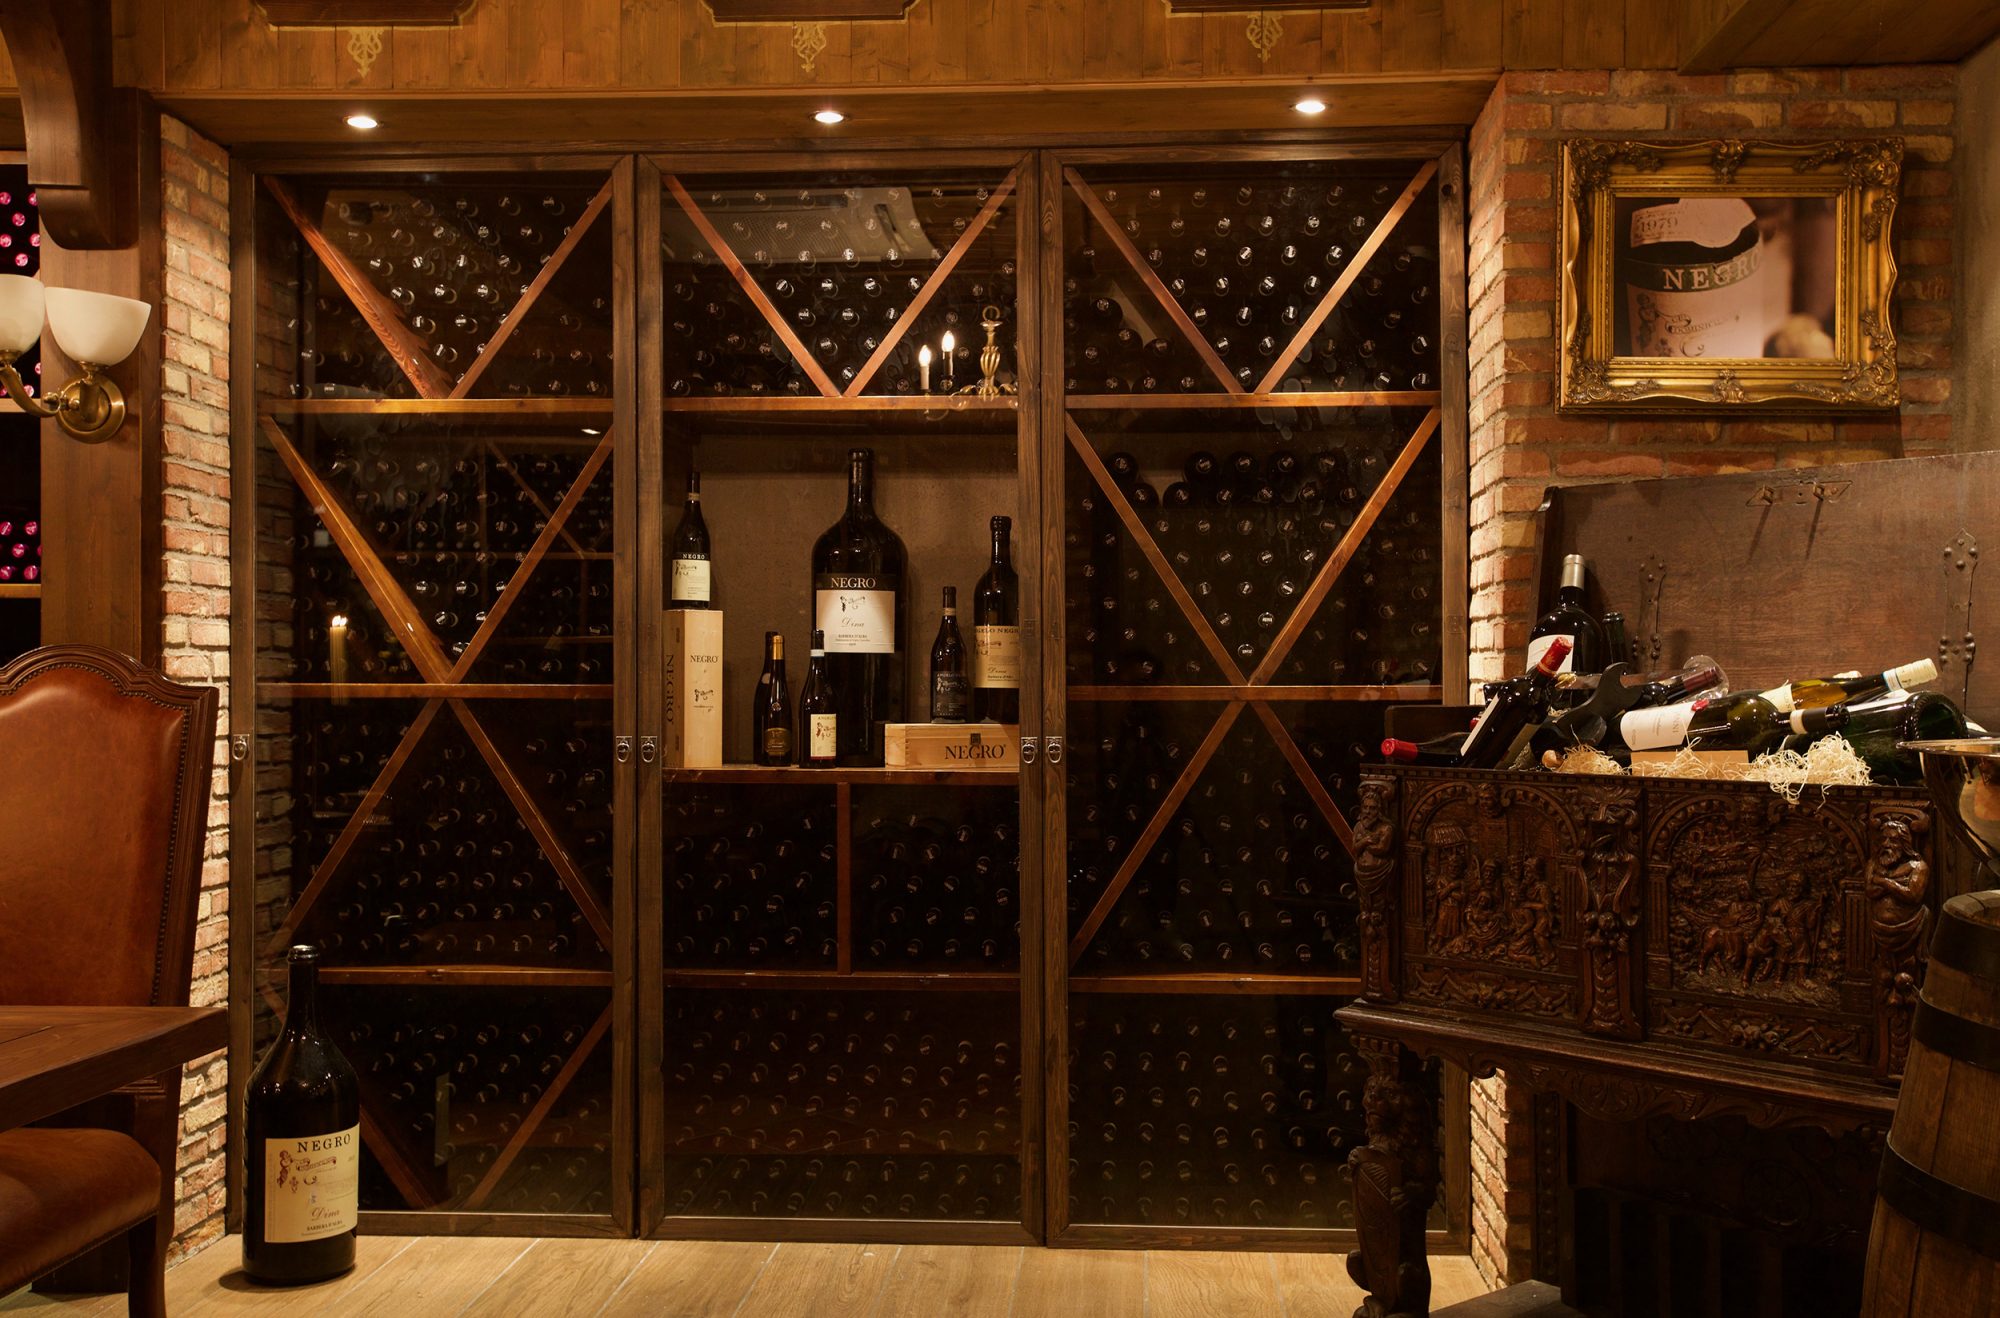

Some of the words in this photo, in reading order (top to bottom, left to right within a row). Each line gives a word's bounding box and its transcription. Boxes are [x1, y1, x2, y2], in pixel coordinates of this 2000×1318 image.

[1640, 216, 1679, 233] 1979
[1662, 250, 1761, 291] NEGRO
[830, 577, 876, 588] NEGRO
[690, 655, 718, 663] NEGRO
[666, 655, 674, 722] NEGRO
[944, 745, 1005, 760] NEGRO
[297, 1133, 351, 1153] NEGRO
